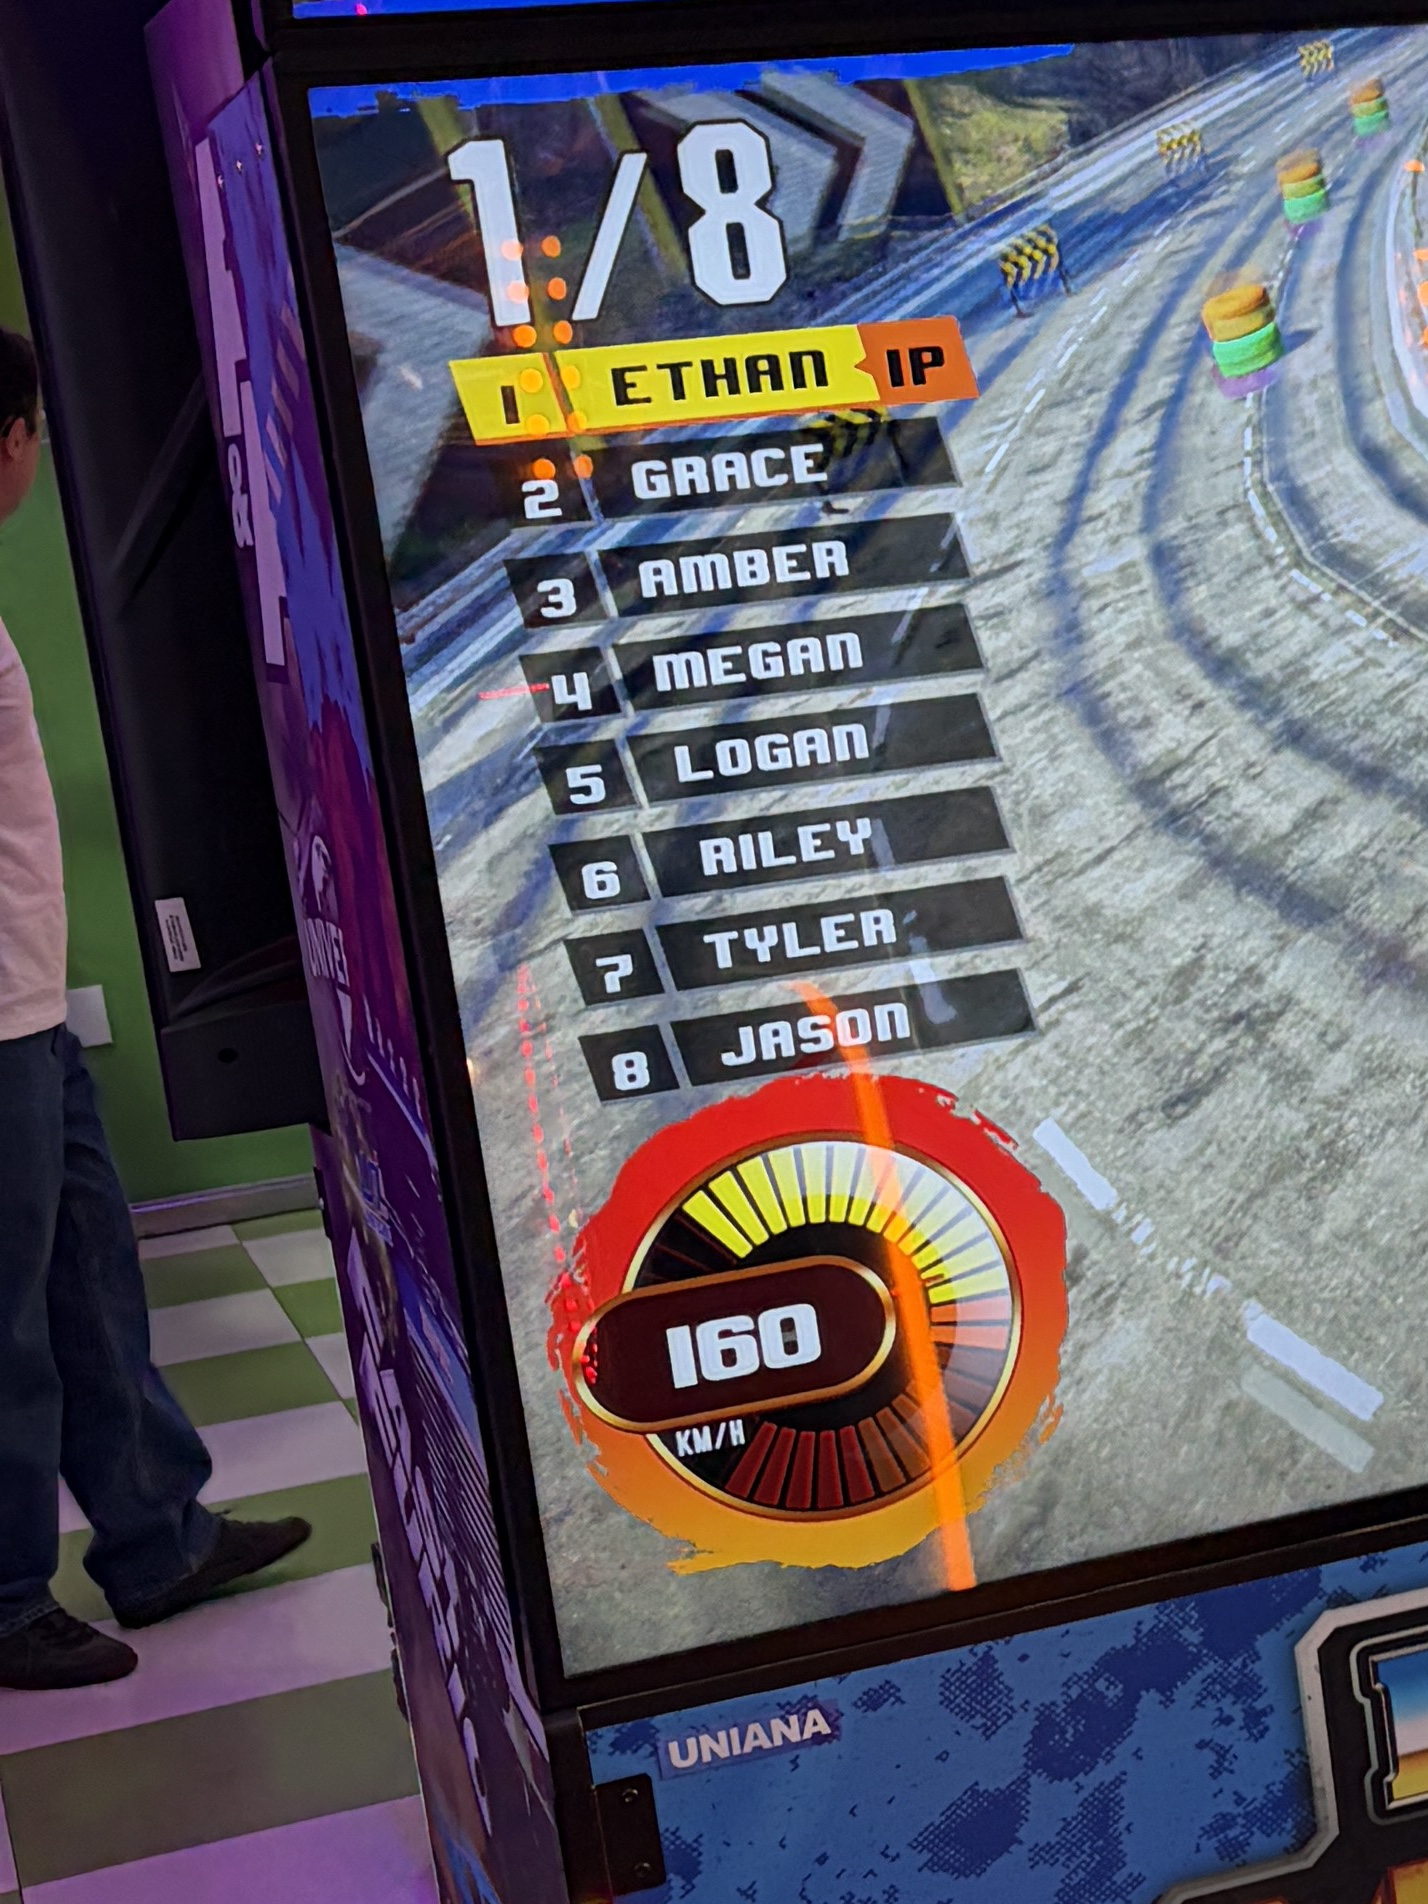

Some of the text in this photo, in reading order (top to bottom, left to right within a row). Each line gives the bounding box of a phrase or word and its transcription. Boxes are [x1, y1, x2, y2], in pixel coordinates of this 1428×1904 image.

[446, 118, 788, 327] 1/8
[609, 348, 828, 408] ETHAN
[885, 344, 947, 389] 1P
[520, 442, 828, 521] 2 GRACE
[535, 539, 850, 621] 3 AMBER
[549, 631, 864, 712] 4 MEGAN
[564, 722, 870, 806] 5 LOGAN
[579, 815, 873, 901] 6 RILEY
[593, 906, 897, 995] 7 TYLER
[610, 1000, 912, 1092] 8 JASON
[665, 1301, 825, 1391] 160
[675, 1418, 748, 1459] KM/H
[666, 1706, 833, 1770] UNIANA
